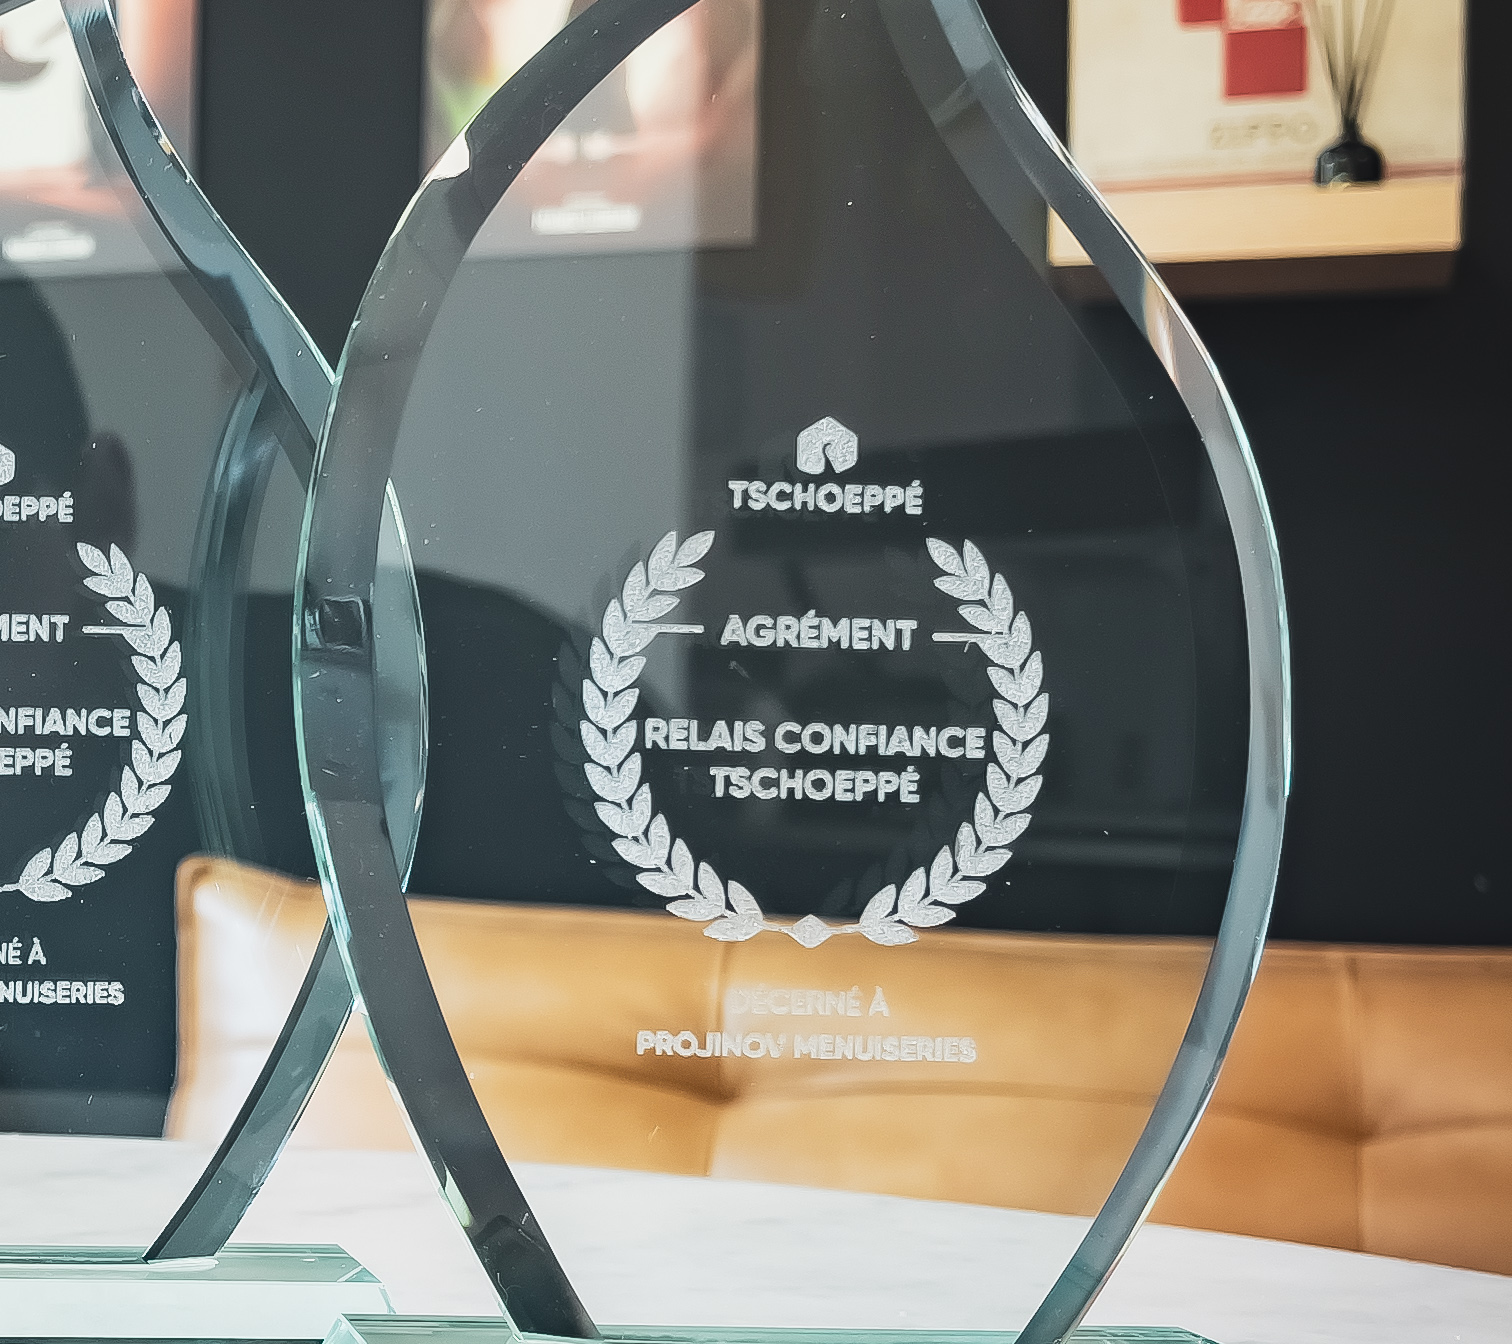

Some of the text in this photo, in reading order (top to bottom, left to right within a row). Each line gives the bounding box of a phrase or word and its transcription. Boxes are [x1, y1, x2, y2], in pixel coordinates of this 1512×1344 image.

[728, 479, 923, 515] TSCHOEPPÉ
[720, 610, 917, 651] AGRÉMENT
[644, 717, 986, 759] RELAIS CONFIANCE
[710, 765, 920, 803] TSCHOEPPÉ
[27, 937, 47, 965] À
[732, 984, 890, 1017] DÉCERNÉ À
[636, 1030, 978, 1063] PROJINOV MENUISERIES
